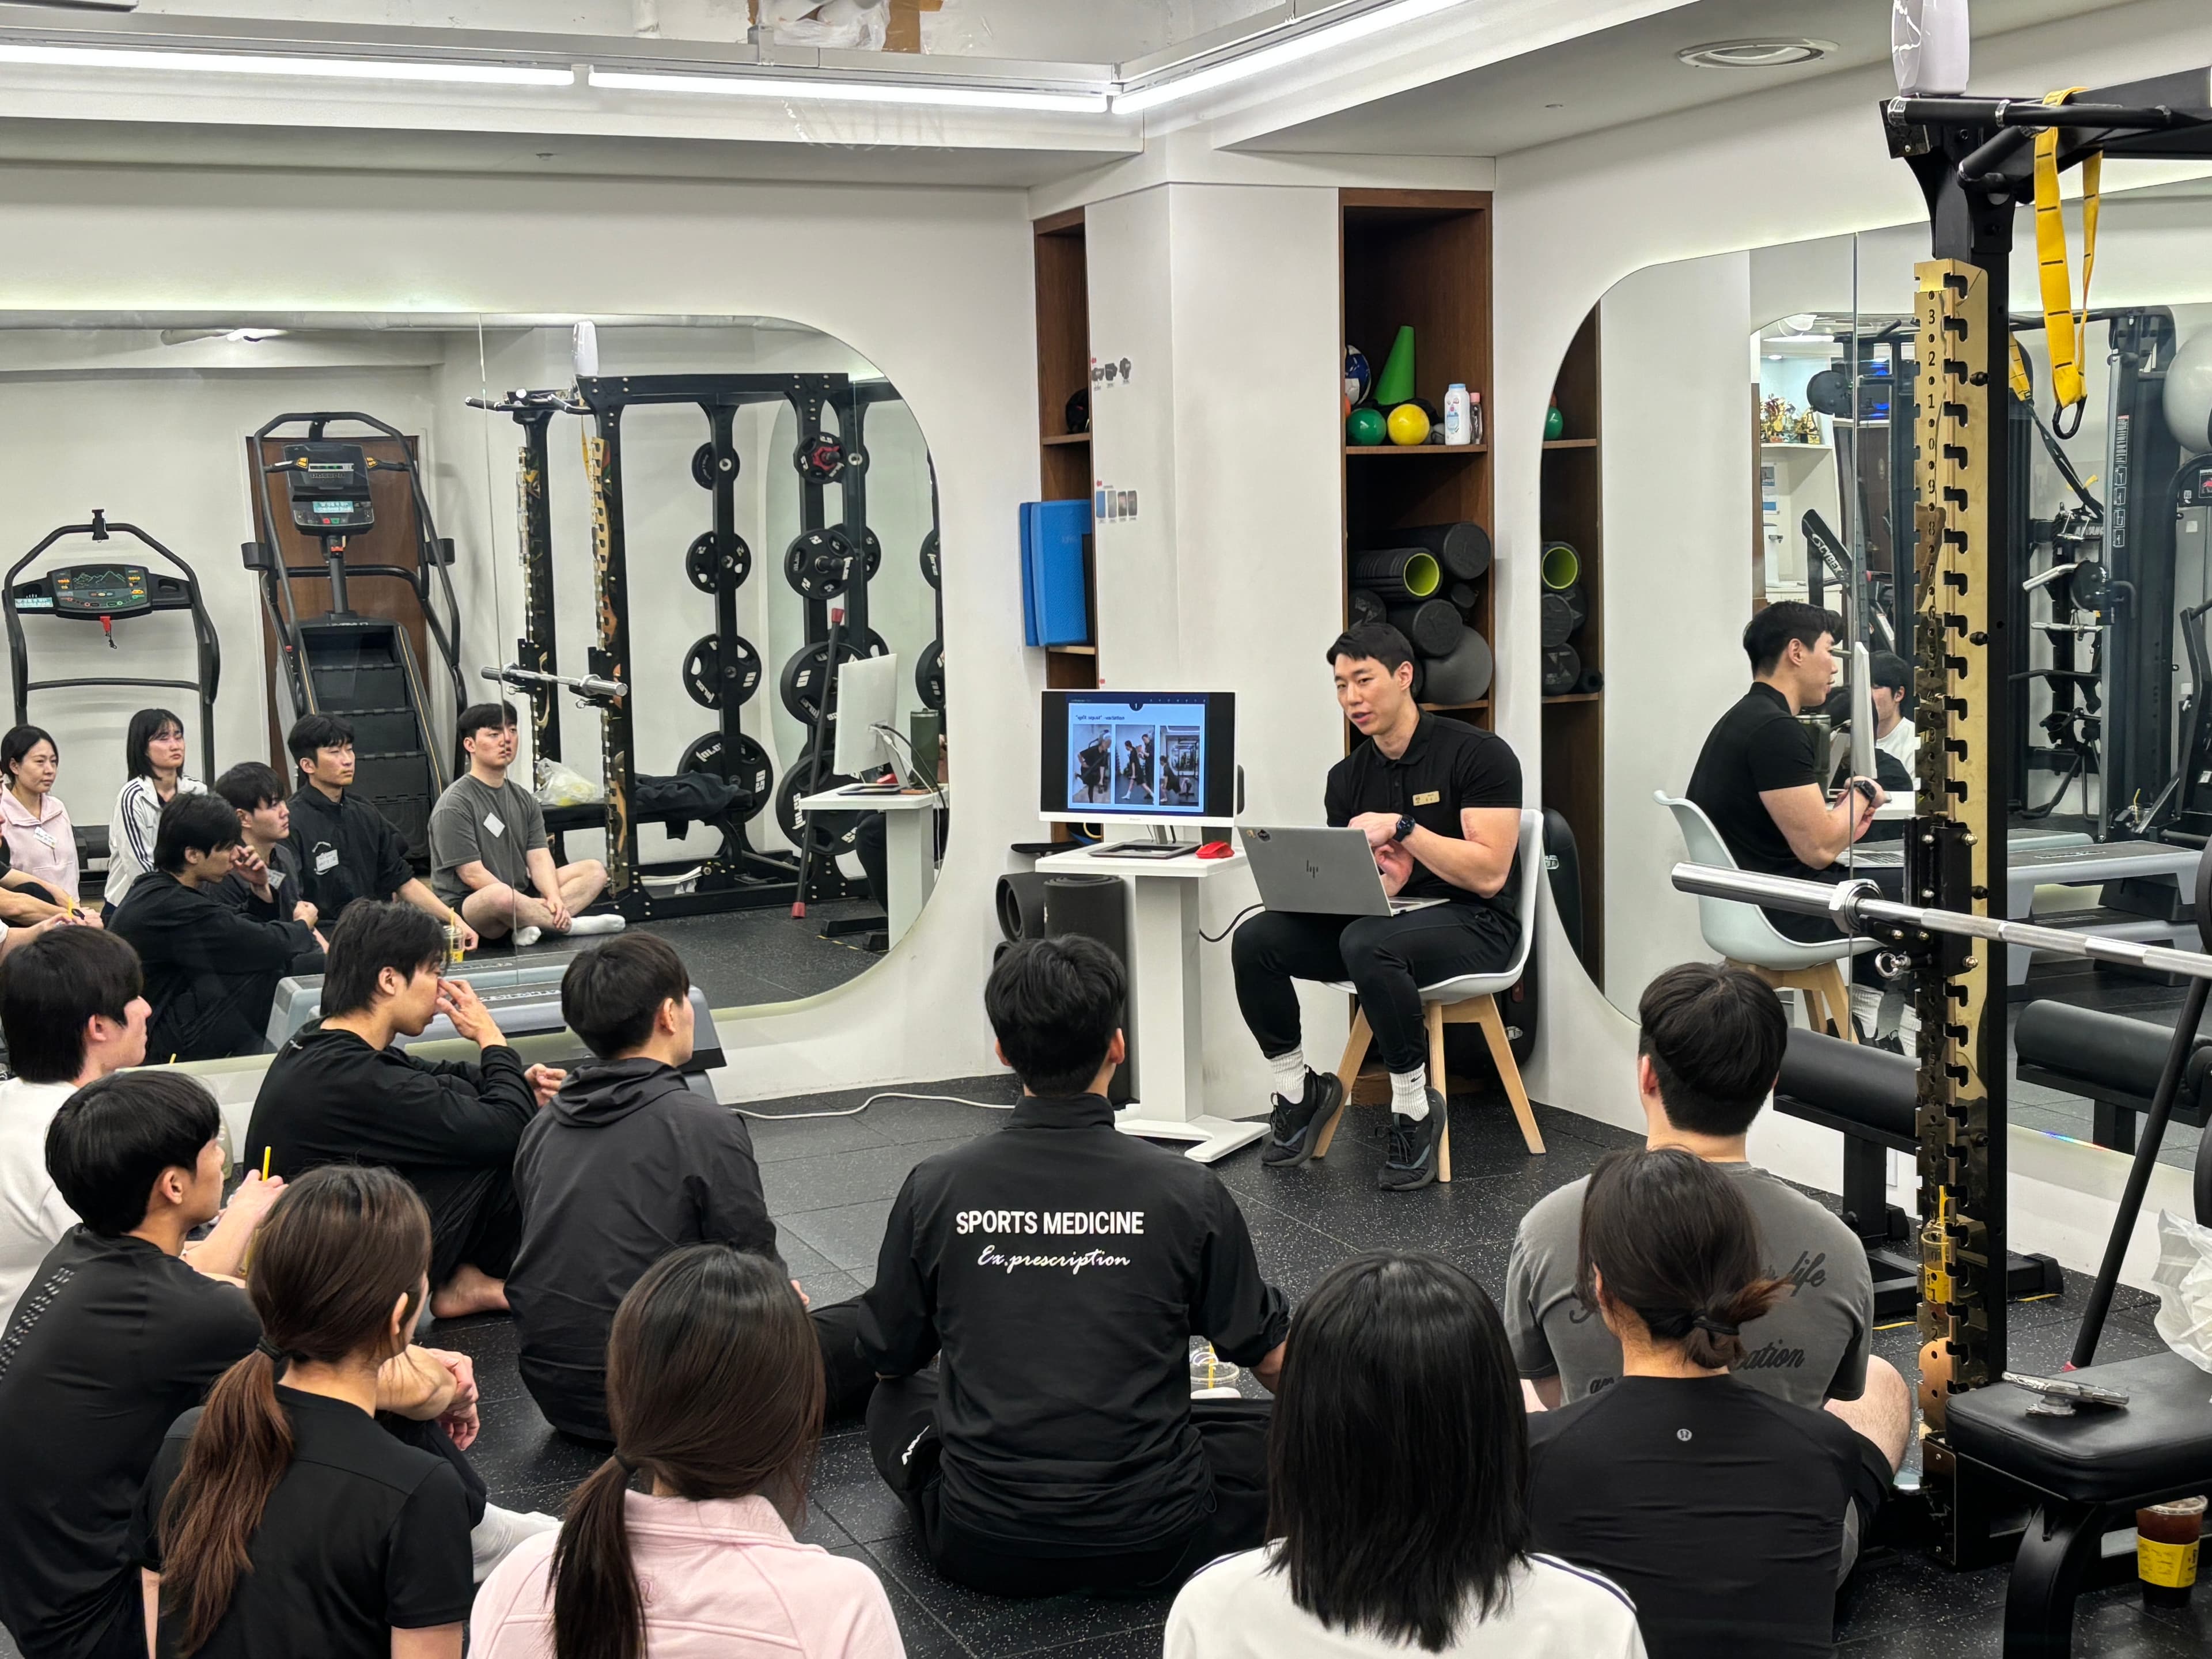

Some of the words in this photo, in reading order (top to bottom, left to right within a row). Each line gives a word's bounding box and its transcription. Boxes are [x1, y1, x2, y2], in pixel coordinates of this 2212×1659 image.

[1928, 308, 1936, 324] 3
[1928, 351, 1936, 366] 2
[1927, 393, 1935, 409] 1
[1928, 437, 1935, 450] 0
[1927, 478, 1936, 494] 9
[1928, 520, 1936, 536] 8
[1306, 859, 1319, 878] hp
[956, 1210, 1038, 1235] SPORTS
[1043, 1211, 1145, 1235] MEDICINE
[977, 1245, 1131, 1275] Ex.prescription
[1789, 1251, 1827, 1297] life
[1931, 1327, 1938, 1342] 2
[1735, 1339, 1805, 1370] ation
